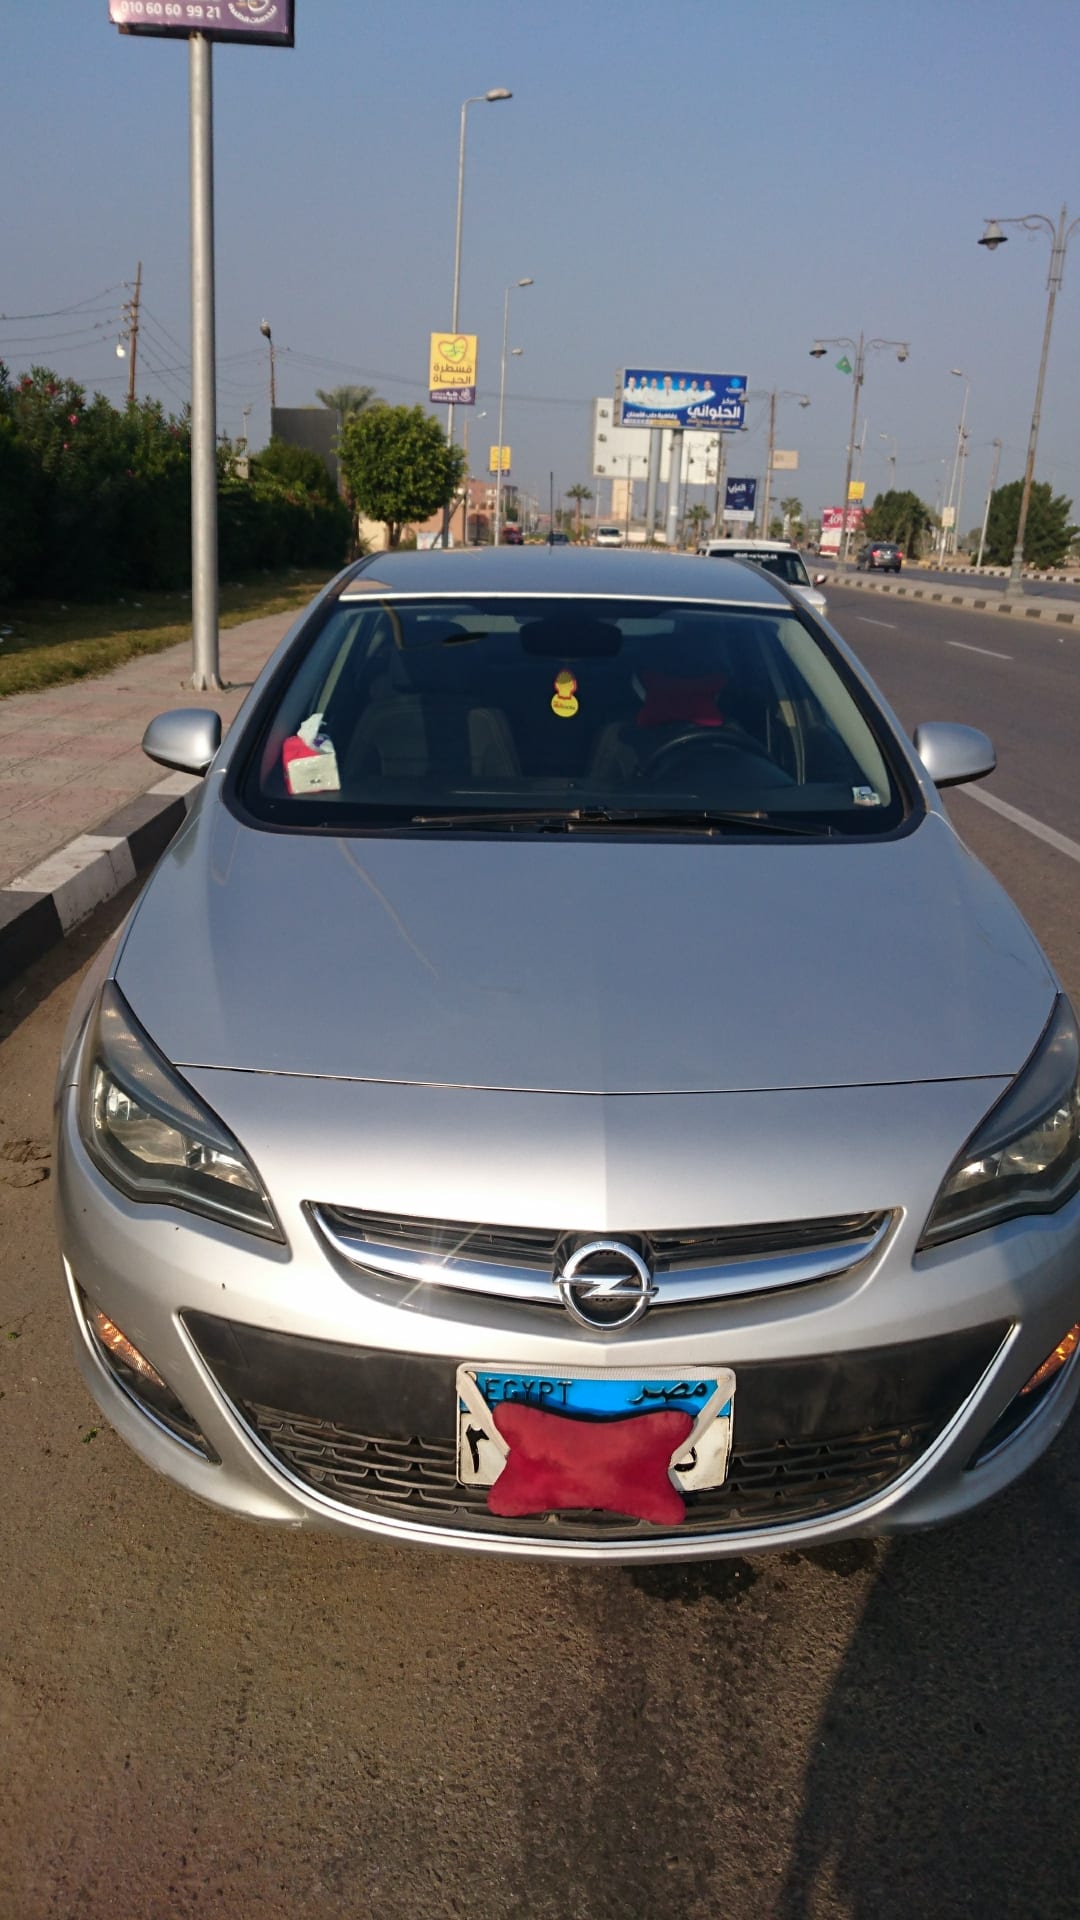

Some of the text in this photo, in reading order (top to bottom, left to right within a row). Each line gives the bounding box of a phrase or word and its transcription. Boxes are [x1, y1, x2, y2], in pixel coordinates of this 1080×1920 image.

[120, 1, 142, 13] 010
[146, 2, 162, 15] 60
[165, 3, 181, 15] 60
[186, 5, 202, 17] 99
[206, 6, 220, 18] 21
[687, 404, 741, 420] الحلواني
[485, 1377, 572, 1406] EGYPT
[628, 1382, 707, 1405] مصر
